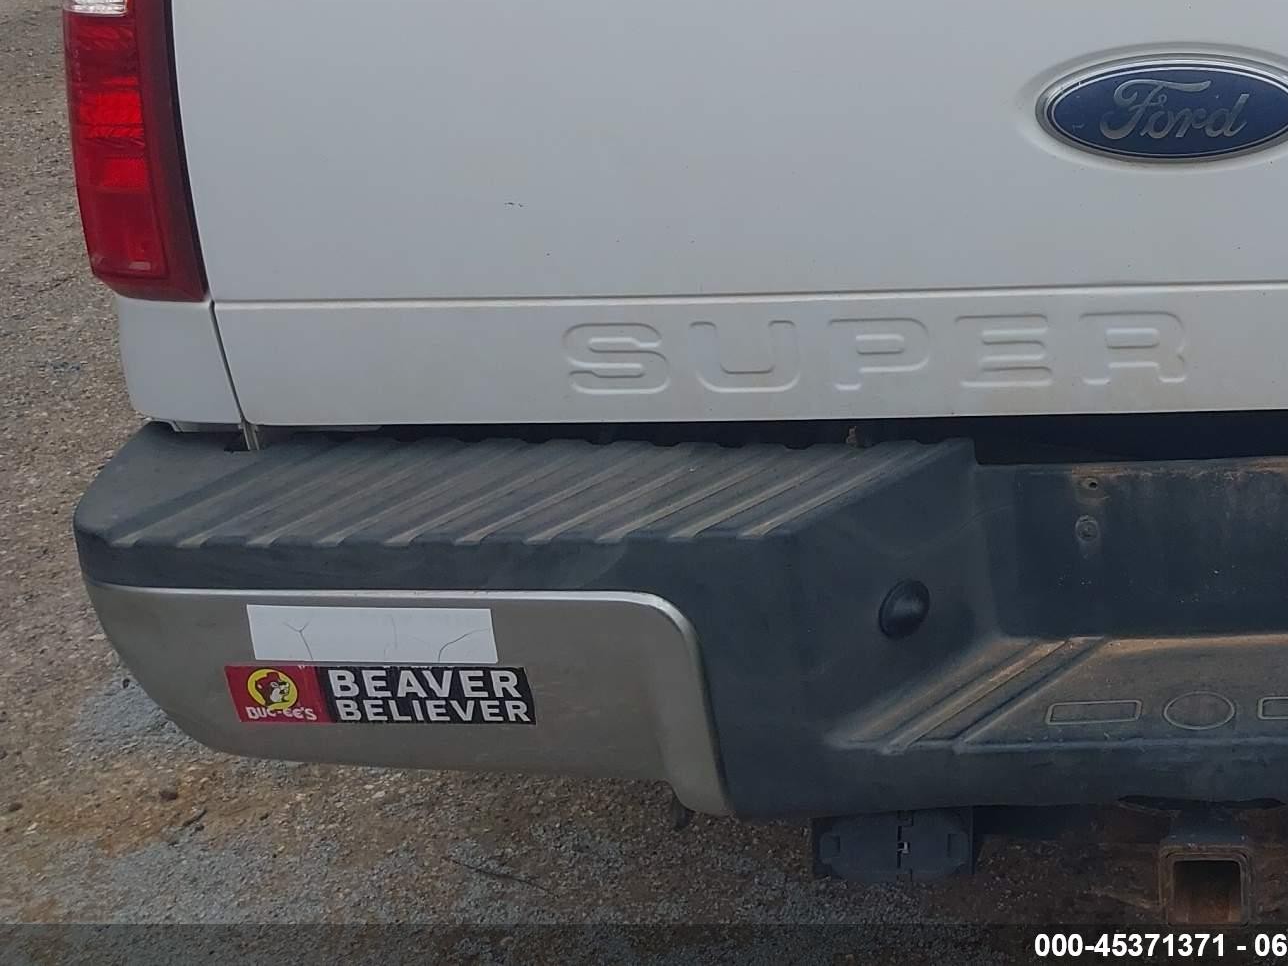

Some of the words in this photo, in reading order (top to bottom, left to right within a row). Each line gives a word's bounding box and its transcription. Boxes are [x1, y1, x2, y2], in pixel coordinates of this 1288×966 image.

[1100, 78, 1250, 140] Ford
[562, 310, 1187, 394] SUPER
[327, 669, 521, 698] BEAVER
[335, 699, 531, 722] BELIEVER
